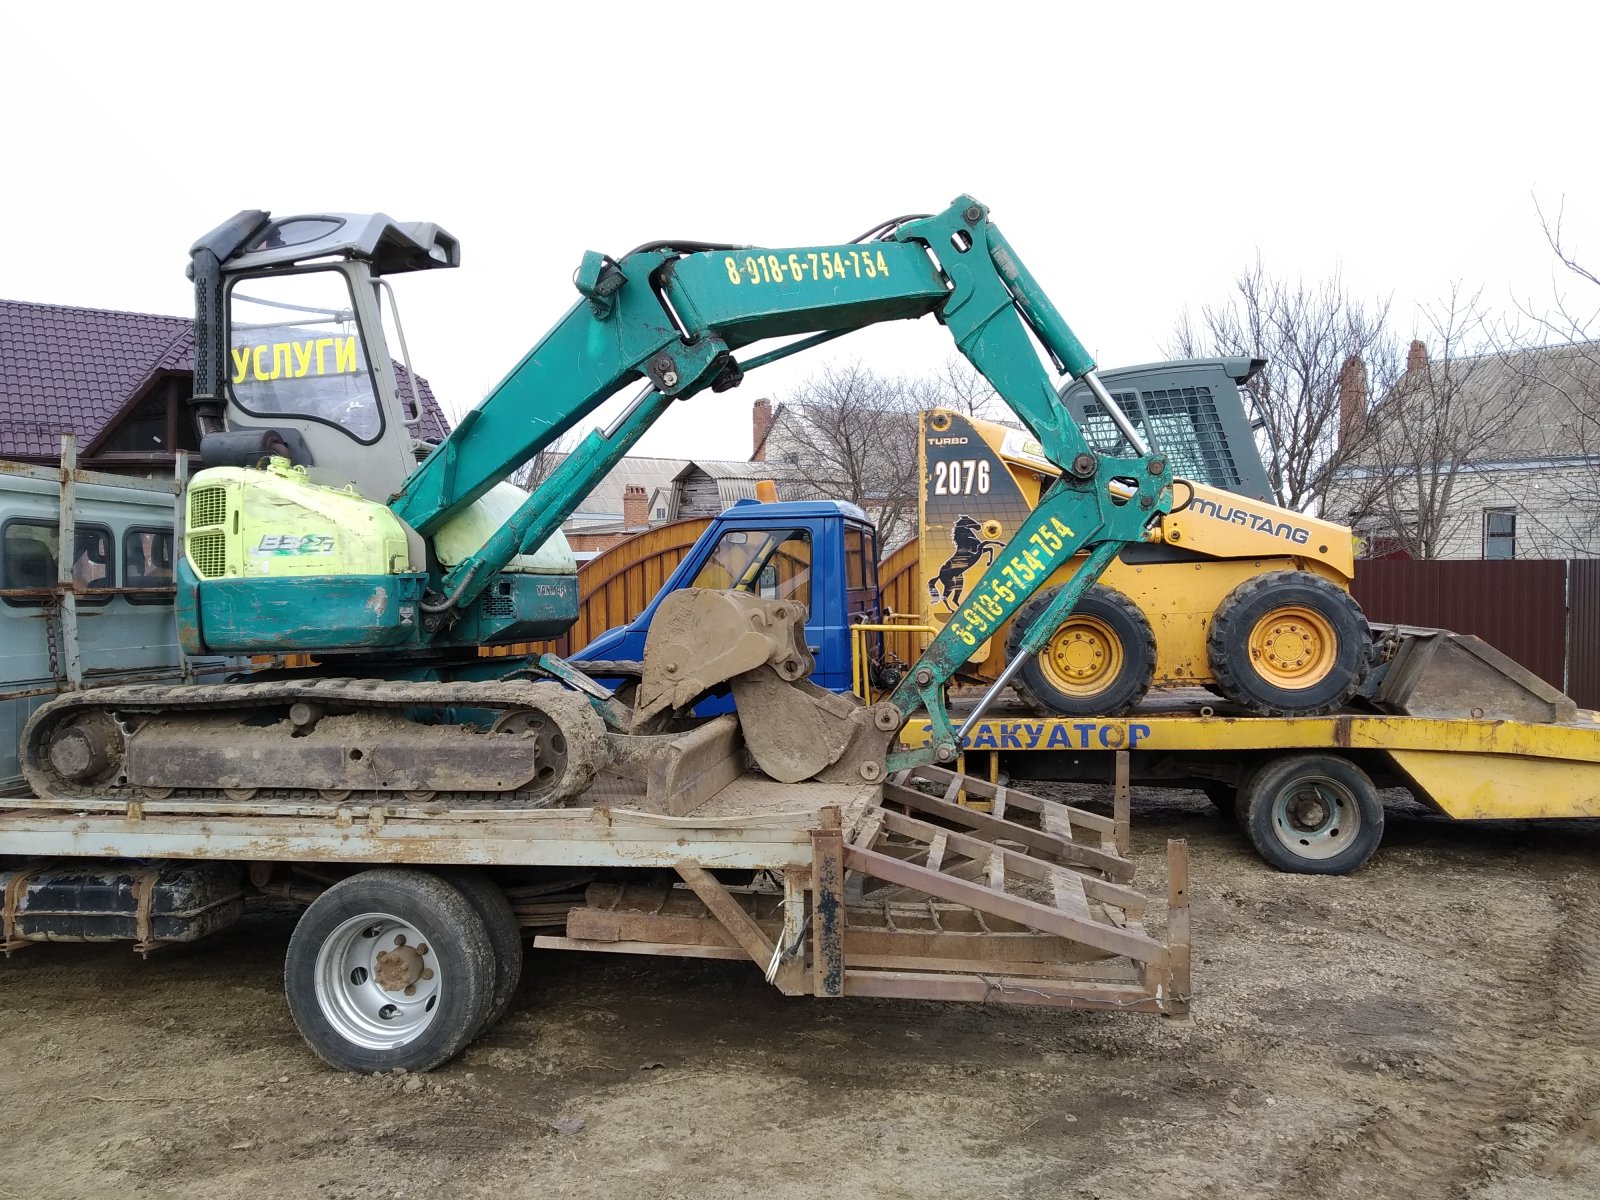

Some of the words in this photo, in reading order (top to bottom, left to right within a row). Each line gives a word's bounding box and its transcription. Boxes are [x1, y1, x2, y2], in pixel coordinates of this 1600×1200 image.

[724, 250, 889, 285] 8-918-6-754-754
[231, 336, 357, 384] УСЛУГИ
[926, 436, 969, 446] TURBO
[934, 459, 991, 496] 2076
[1188, 497, 1310, 545] MUSTANG
[951, 516, 1075, 646] 8-918-6-754-754
[921, 723, 1151, 749] АКУАТОР
